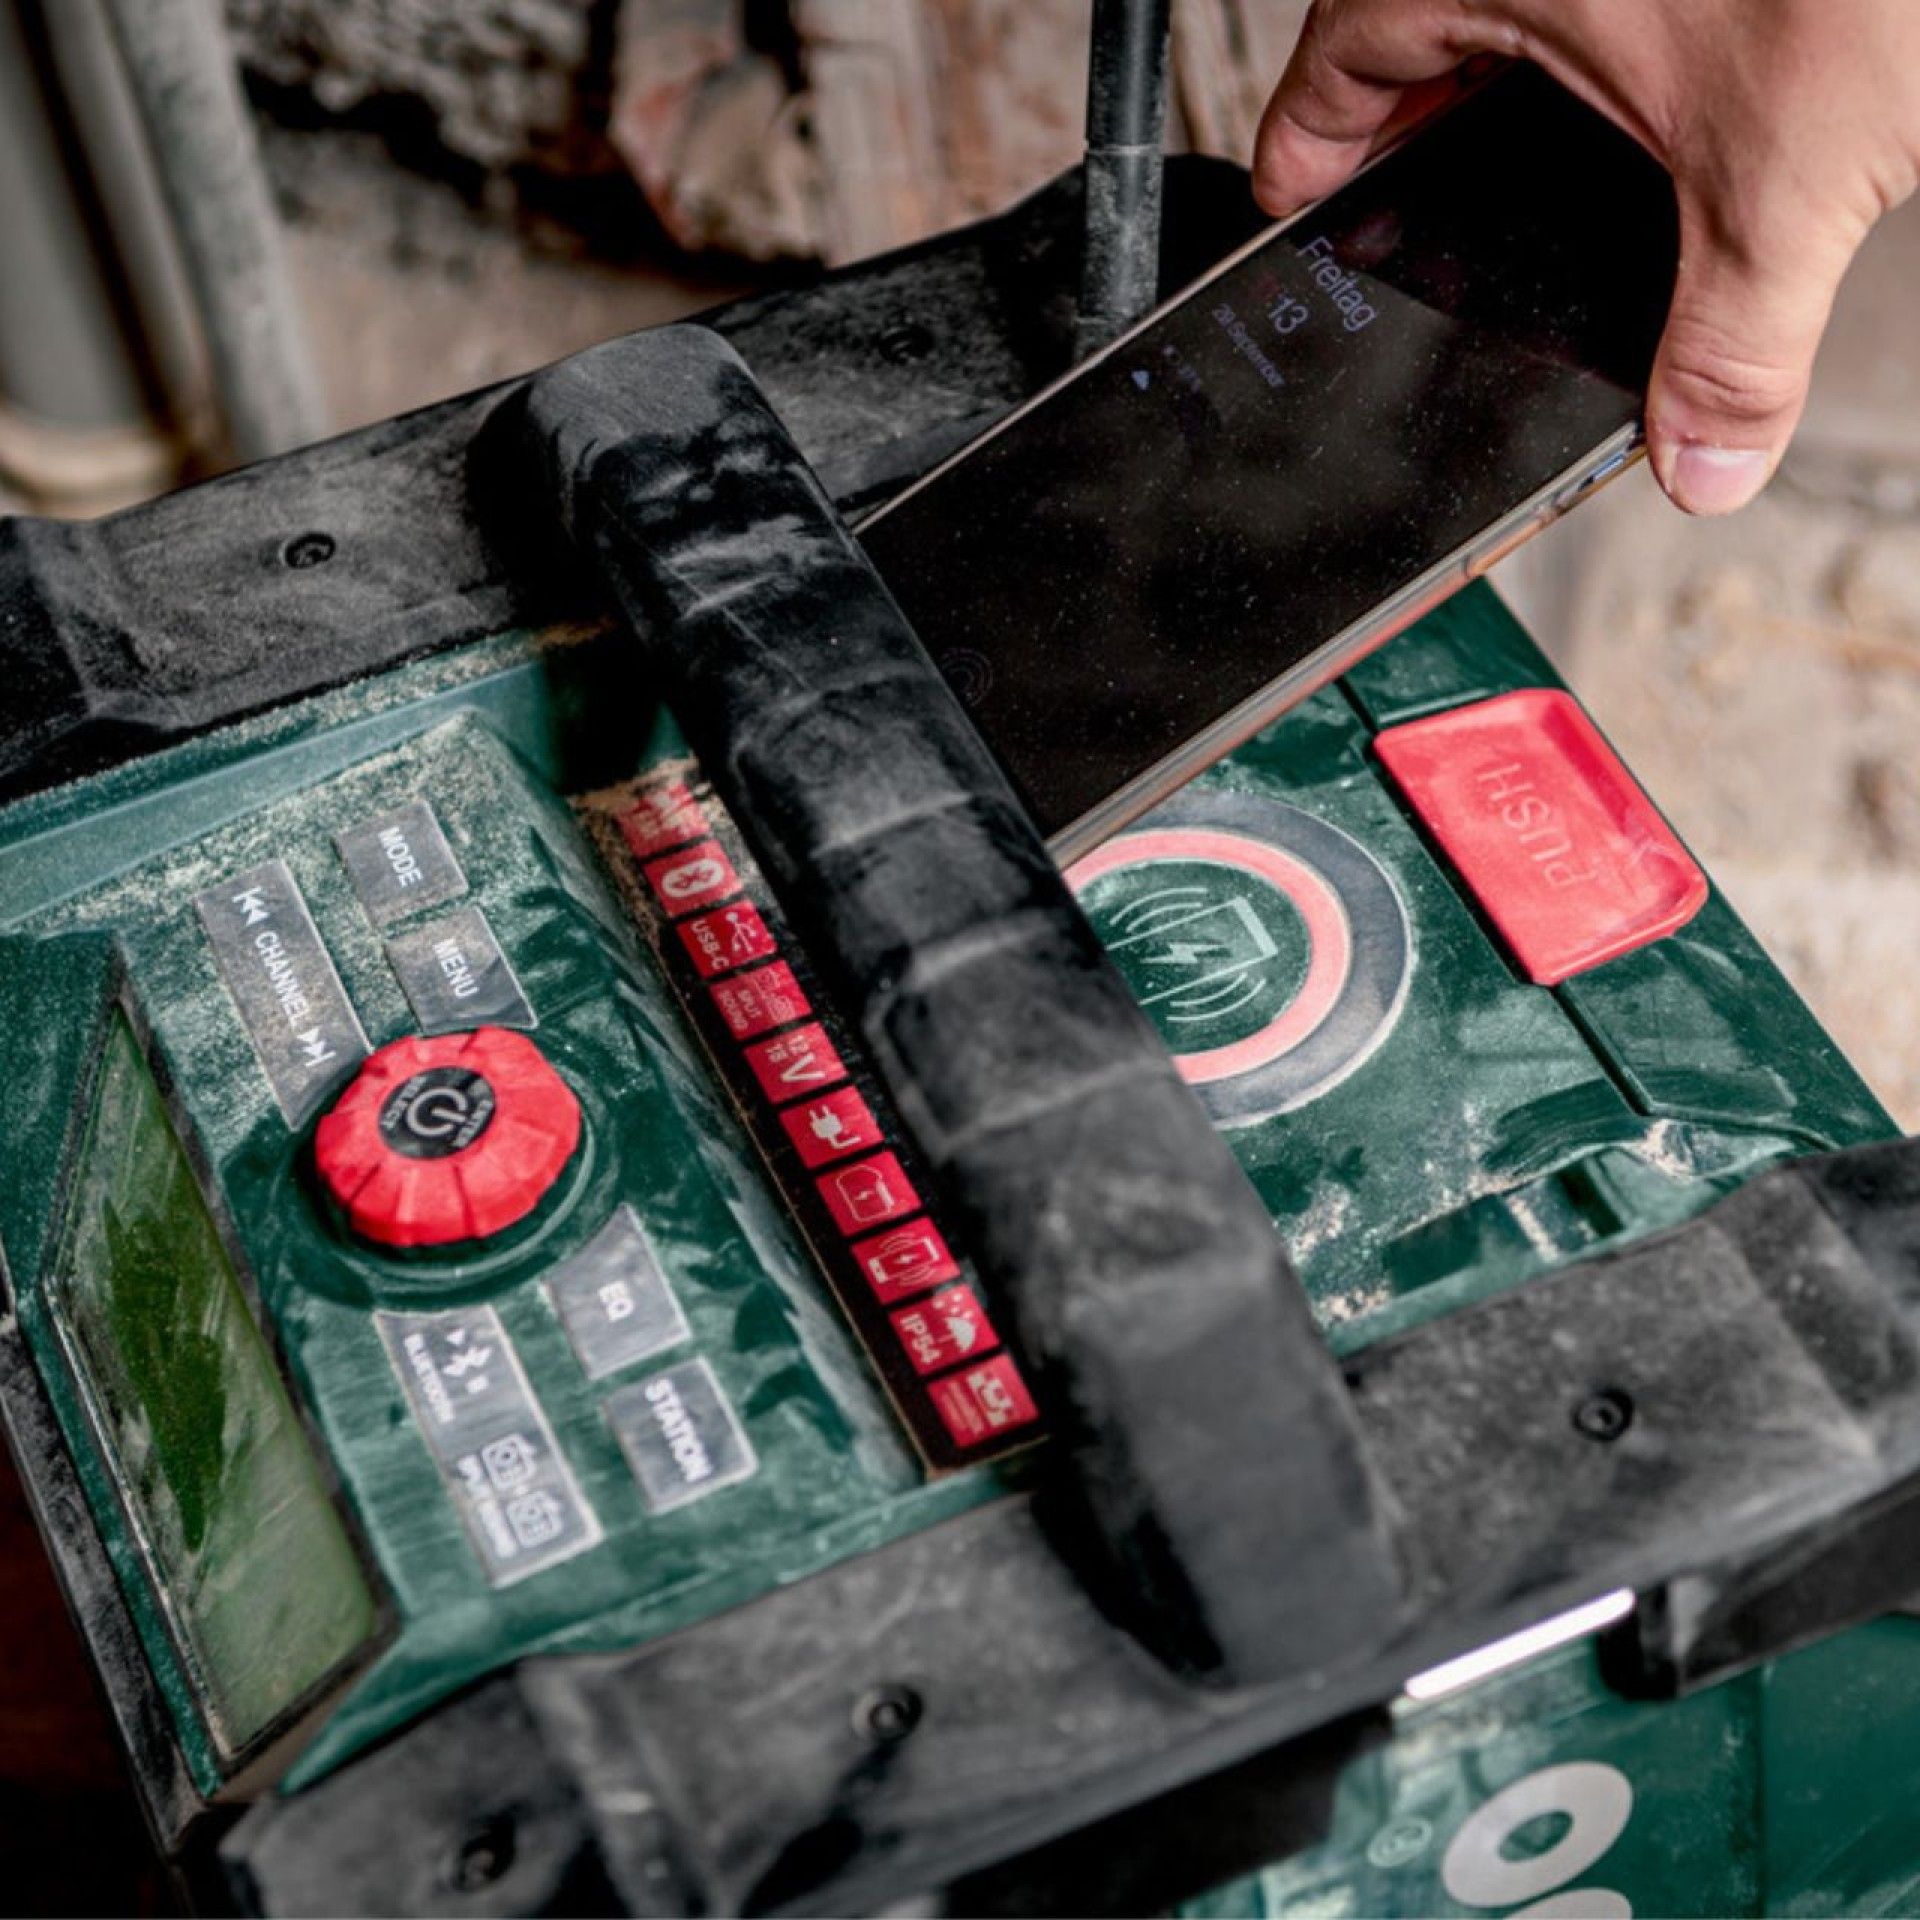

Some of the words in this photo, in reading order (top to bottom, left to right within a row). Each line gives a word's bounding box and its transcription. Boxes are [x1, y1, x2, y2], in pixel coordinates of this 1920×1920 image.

[1268, 290, 1309, 334] 13
[1296, 236, 1378, 332] Freitag
[1476, 762, 1599, 889] PUSH
[377, 826, 424, 889] MODE
[432, 937, 481, 999] MENU
[690, 919, 730, 971] USB-C
[254, 931, 310, 1035] CHANNEL
[899, 1312, 942, 1365] IP54
[644, 1379, 713, 1484] STATION
